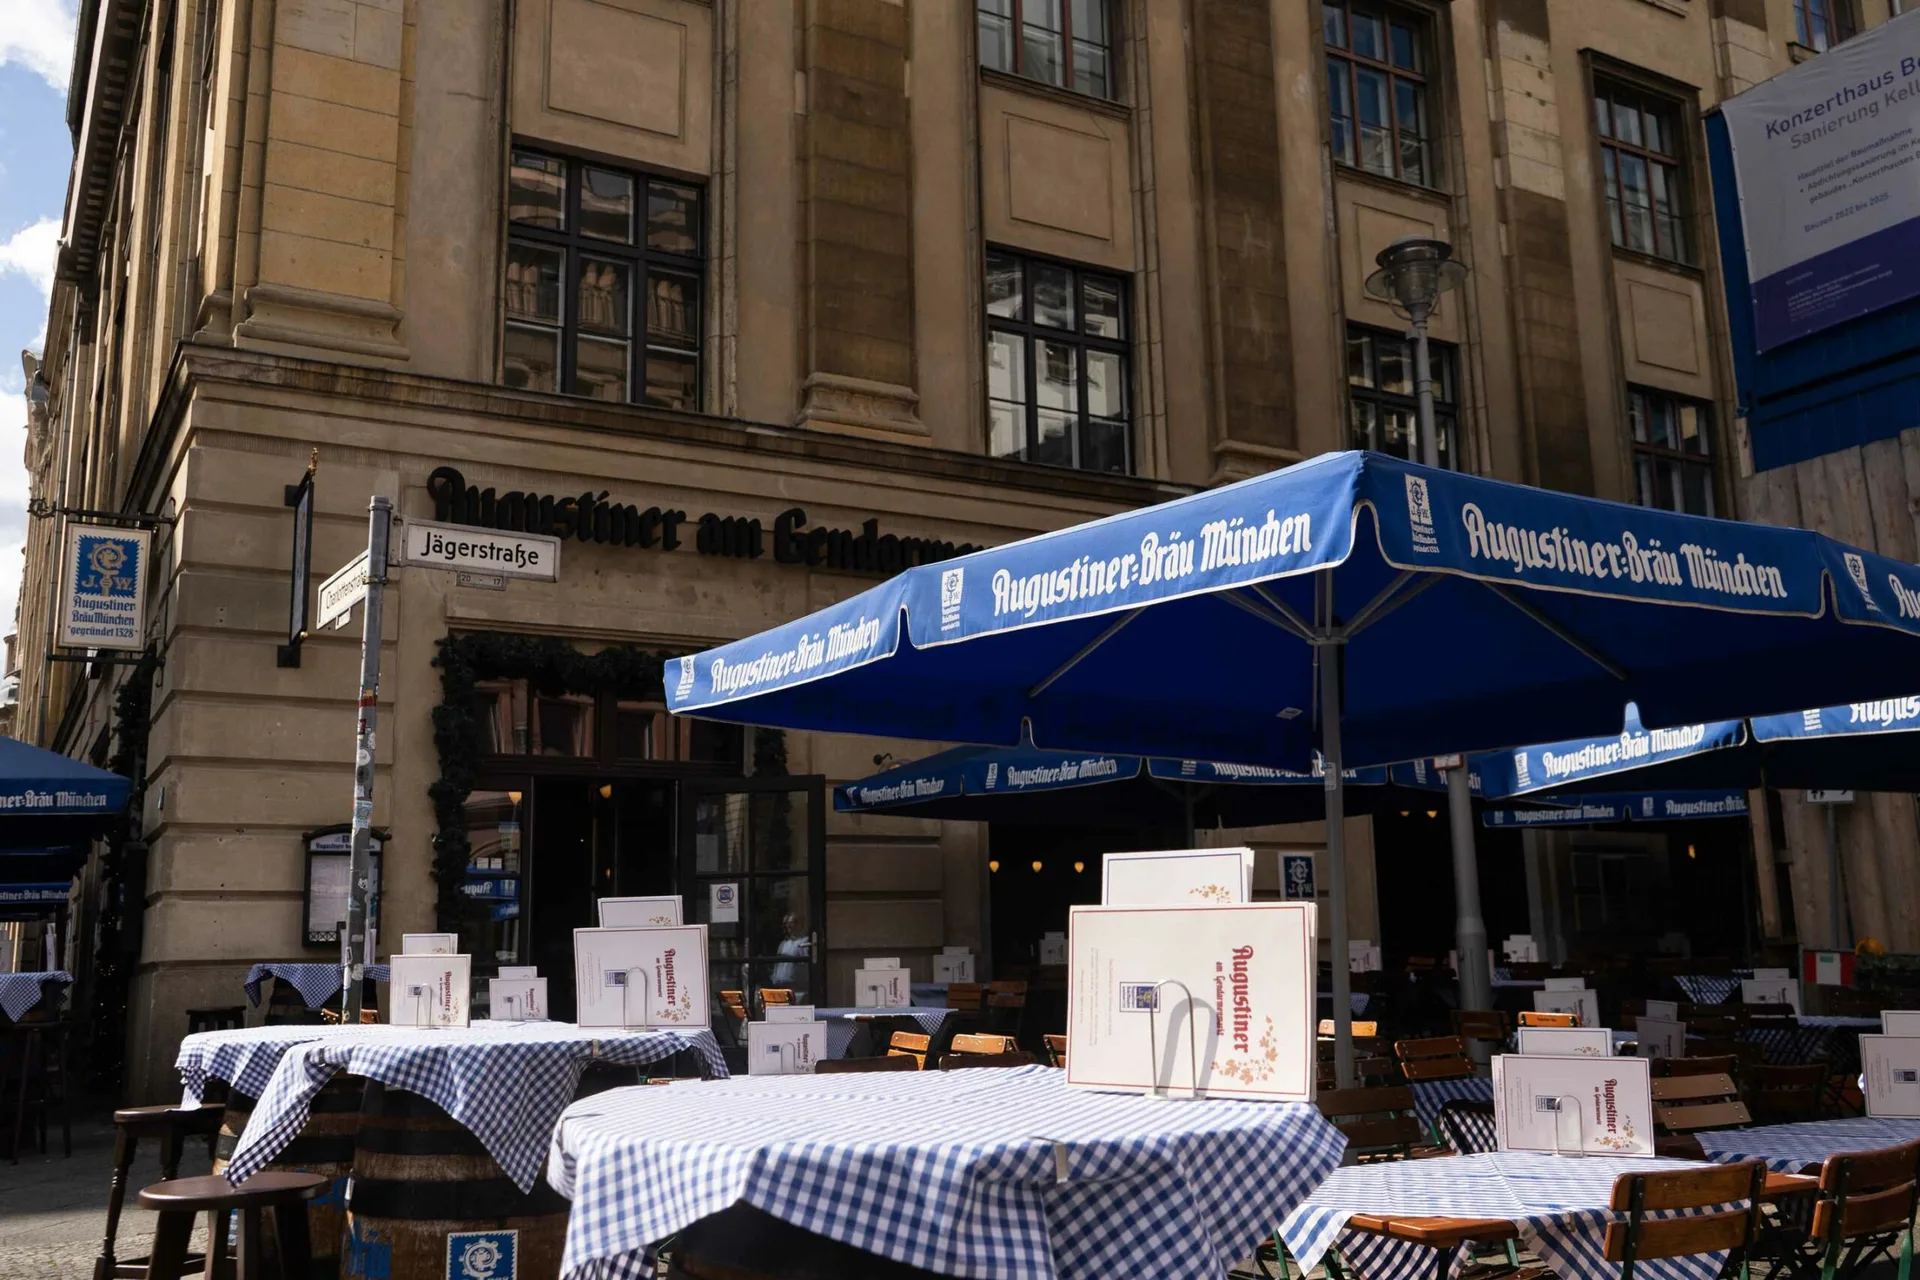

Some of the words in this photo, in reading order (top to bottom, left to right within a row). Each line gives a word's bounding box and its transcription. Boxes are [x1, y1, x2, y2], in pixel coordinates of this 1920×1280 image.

[1766, 70, 1895, 139] Konzerthaus
[1901, 56, 1920, 77] B
[1790, 100, 1880, 150] Sanierung
[421, 531, 539, 568] Jägerstraße
[697, 512, 765, 557] am
[1200, 508, 1312, 573] München
[461, 574, 471, 583] 20
[492, 578, 501, 586] 17
[1681, 543, 1788, 599] München
[70, 625, 114, 637] gegründet
[115, 627, 134, 638] 1328
[1078, 756, 1118, 779] München
[55, 791, 107, 807] München
[663, 948, 677, 1006] Augustiner
[1215, 961, 1223, 972] am
[443, 970, 452, 1012] Augustiner
[1213, 975, 1226, 1036] Gendarmenmarkt
[1229, 945, 1254, 1053] Augustiner
[1602, 1078, 1618, 1134] Augustiner
